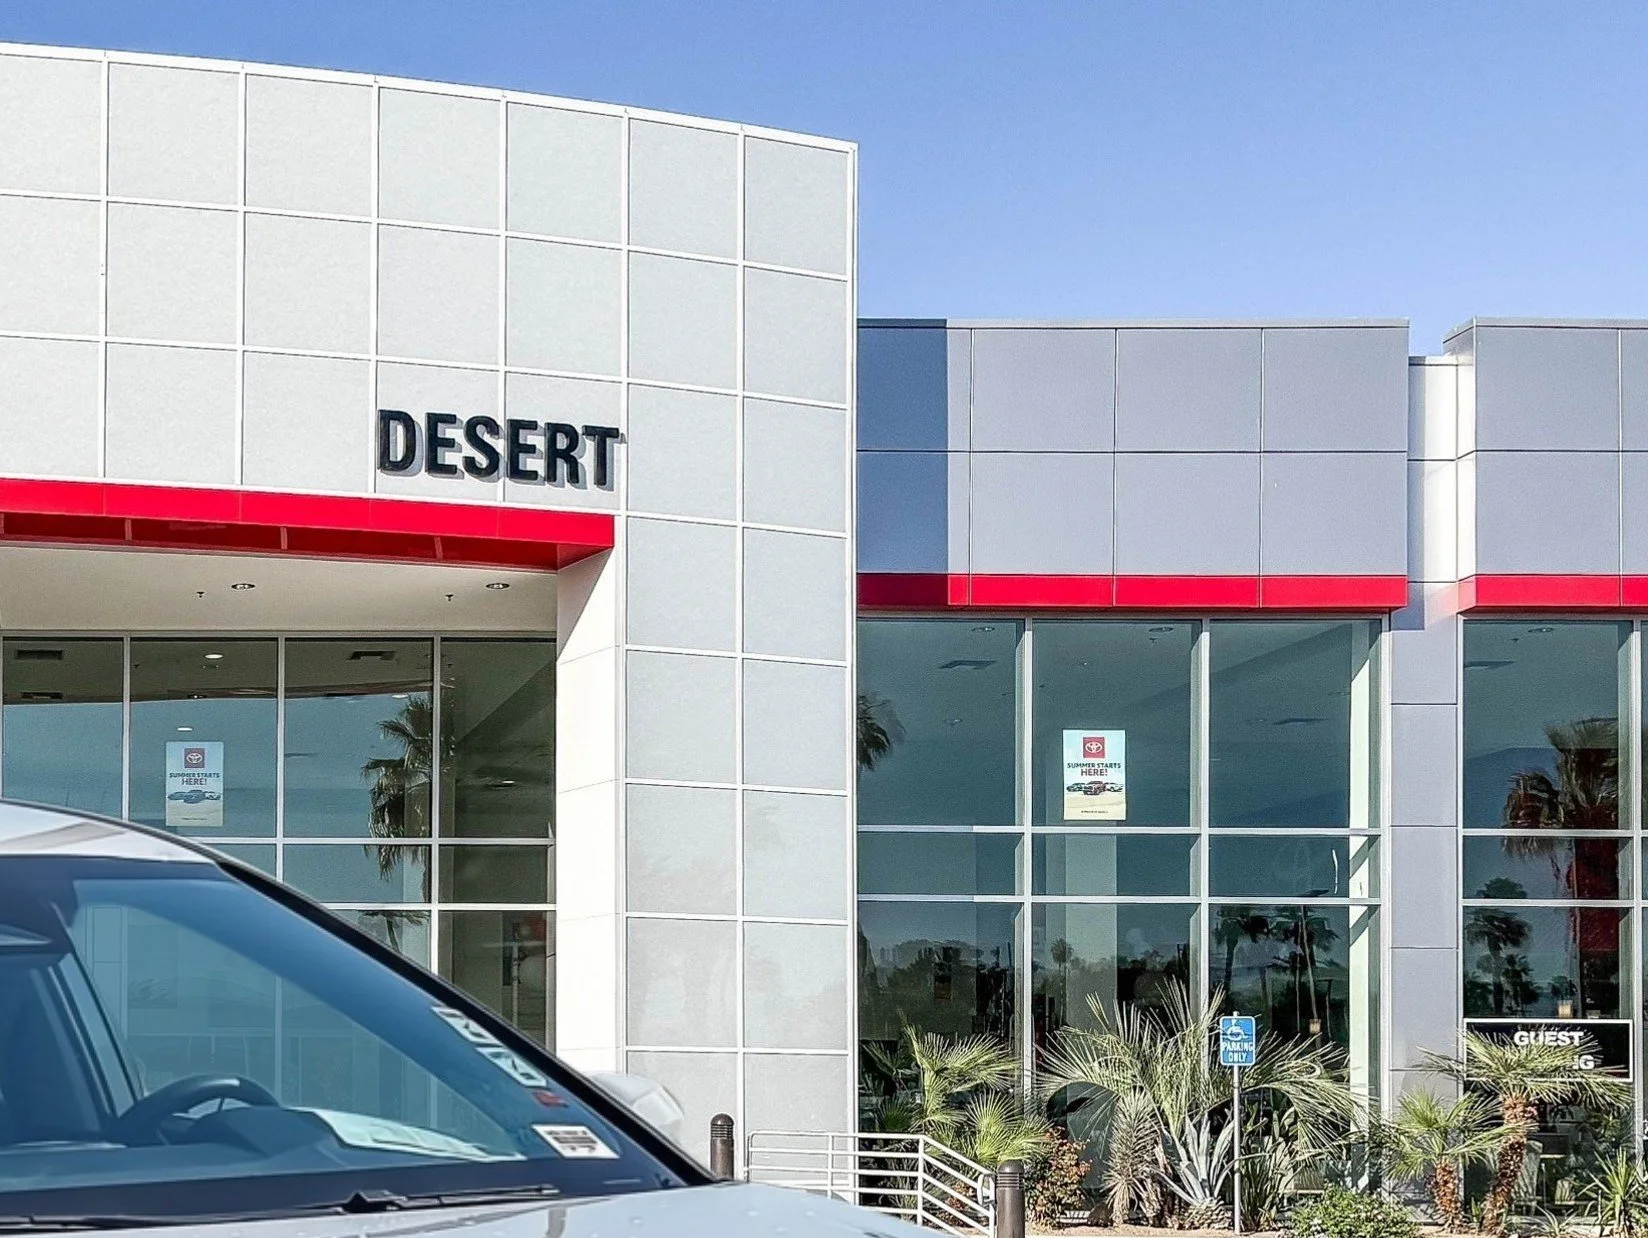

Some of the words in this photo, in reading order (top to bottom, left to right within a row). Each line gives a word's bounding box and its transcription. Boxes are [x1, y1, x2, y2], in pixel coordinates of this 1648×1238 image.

[377, 409, 620, 487] DESERT
[1080, 768, 1108, 776] HERE!
[181, 777, 208, 786] HERE!
[1513, 1030, 1584, 1047] GUEST
[1222, 1040, 1254, 1051] PARKING
[1228, 1051, 1248, 1062] ONLY
